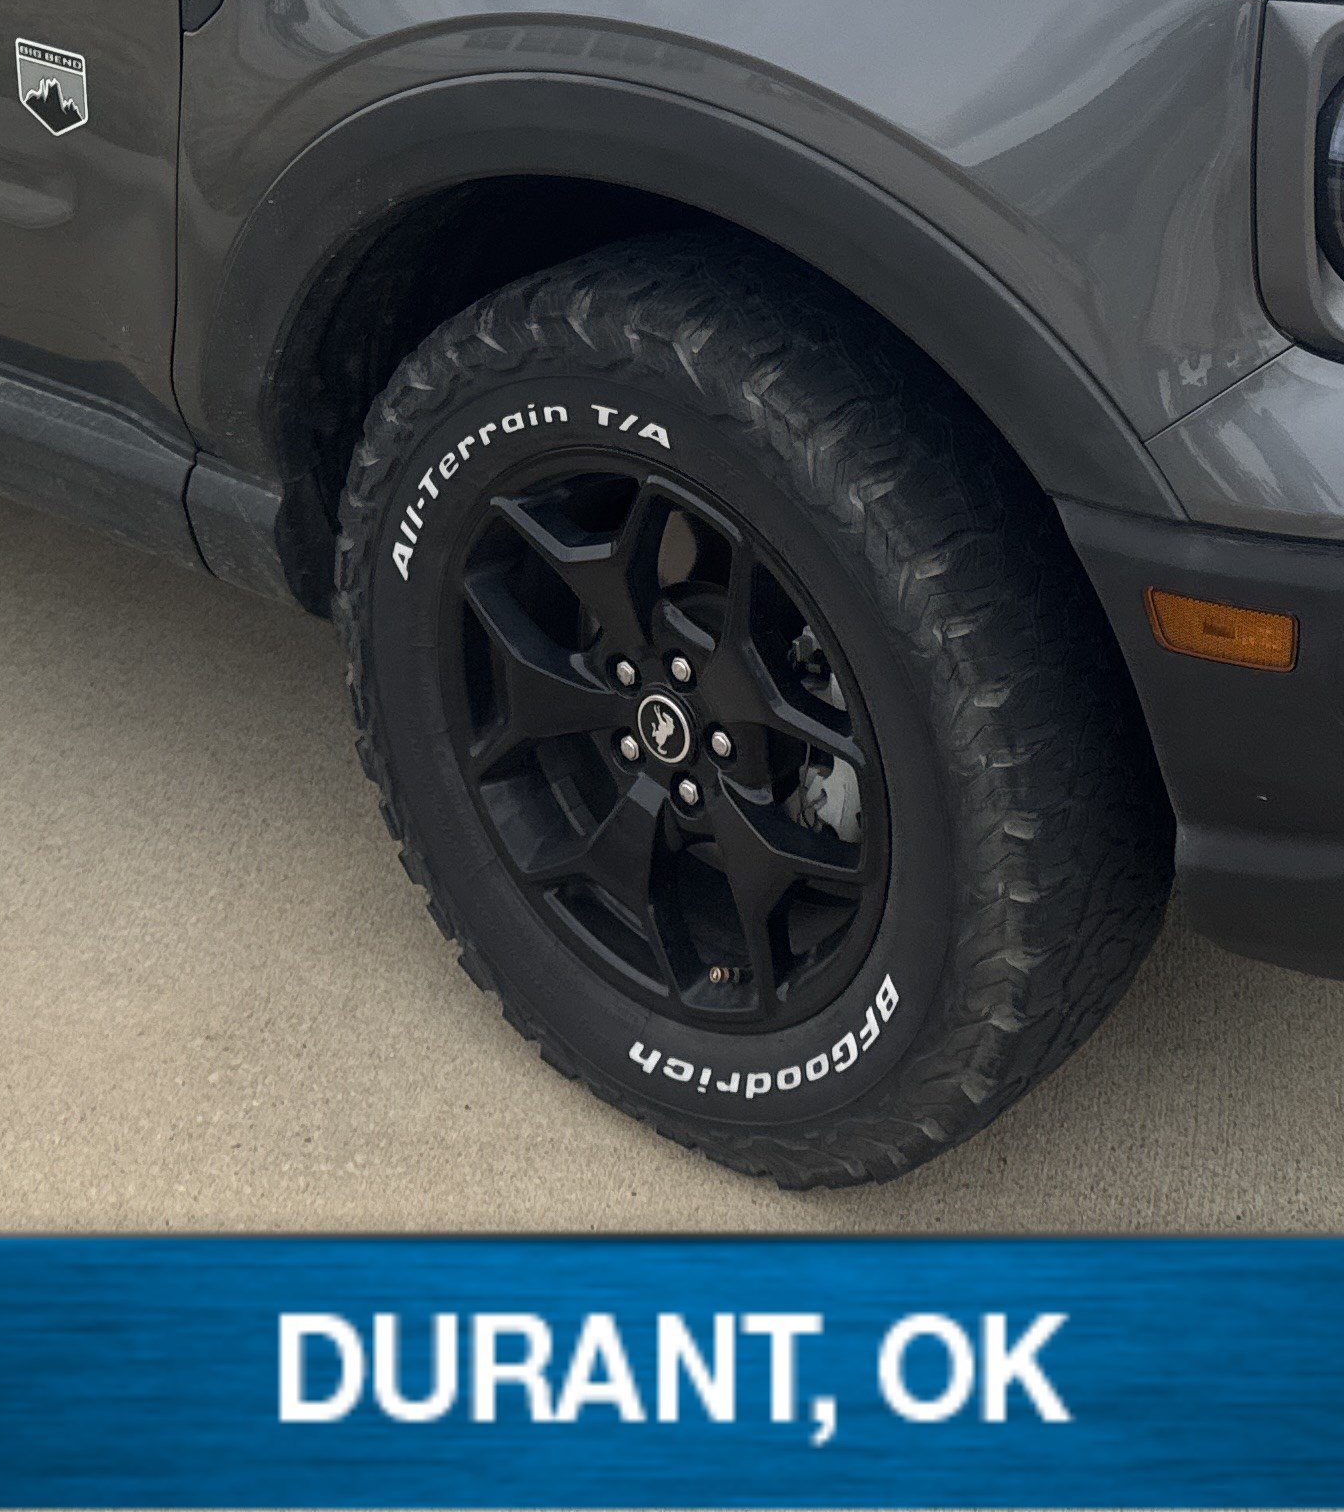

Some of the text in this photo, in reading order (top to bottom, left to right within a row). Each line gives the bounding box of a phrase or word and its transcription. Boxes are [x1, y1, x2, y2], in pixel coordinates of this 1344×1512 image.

[19, 45, 82, 70] BIG BEND
[392, 403, 671, 582] All-Terrain T/A
[628, 973, 900, 1100] BFGoodrich
